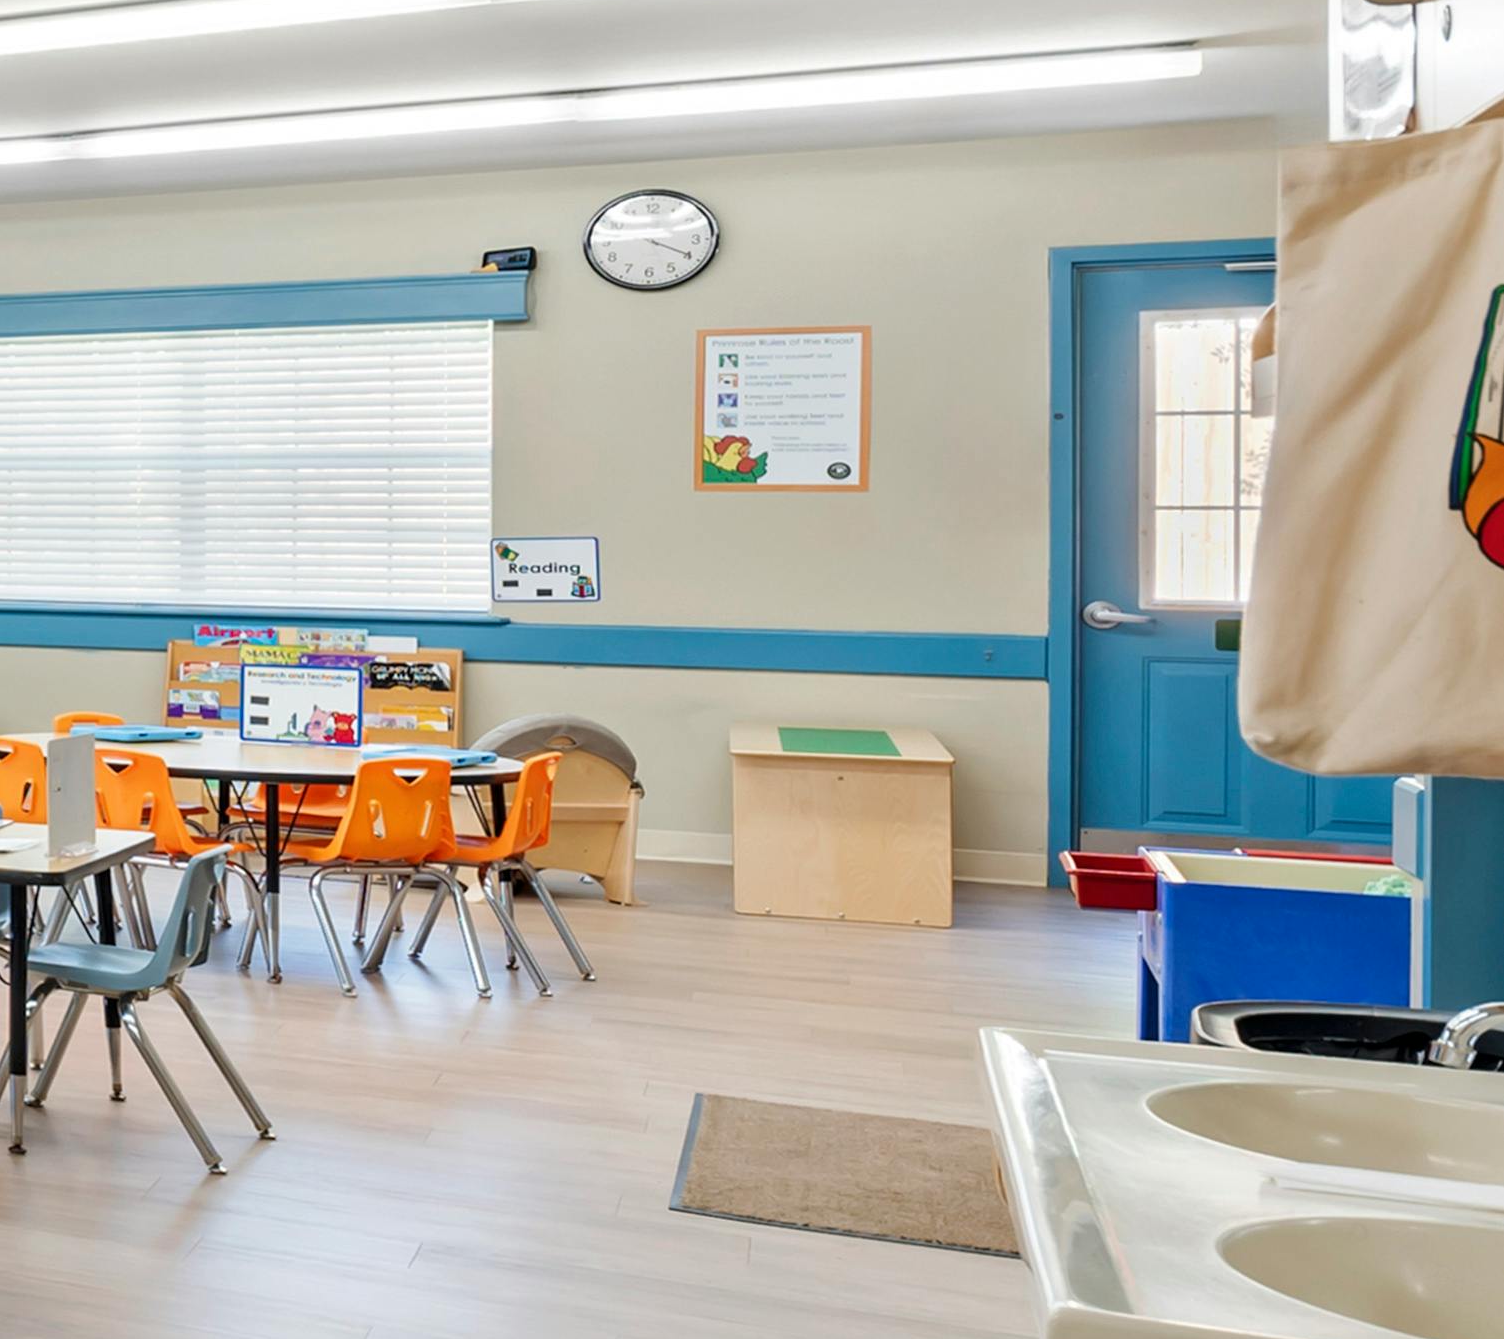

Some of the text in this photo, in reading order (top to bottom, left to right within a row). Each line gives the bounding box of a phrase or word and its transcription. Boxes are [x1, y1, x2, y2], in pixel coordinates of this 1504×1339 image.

[646, 203, 661, 215] 12
[691, 234, 701, 246] 3
[608, 252, 618, 263] 8
[624, 263, 633, 274] 7
[644, 267, 655, 278] 6
[666, 262, 676, 274] 5
[508, 561, 582, 576] Reading
[197, 623, 276, 639] Airport
[247, 670, 357, 683] Research and Technology
